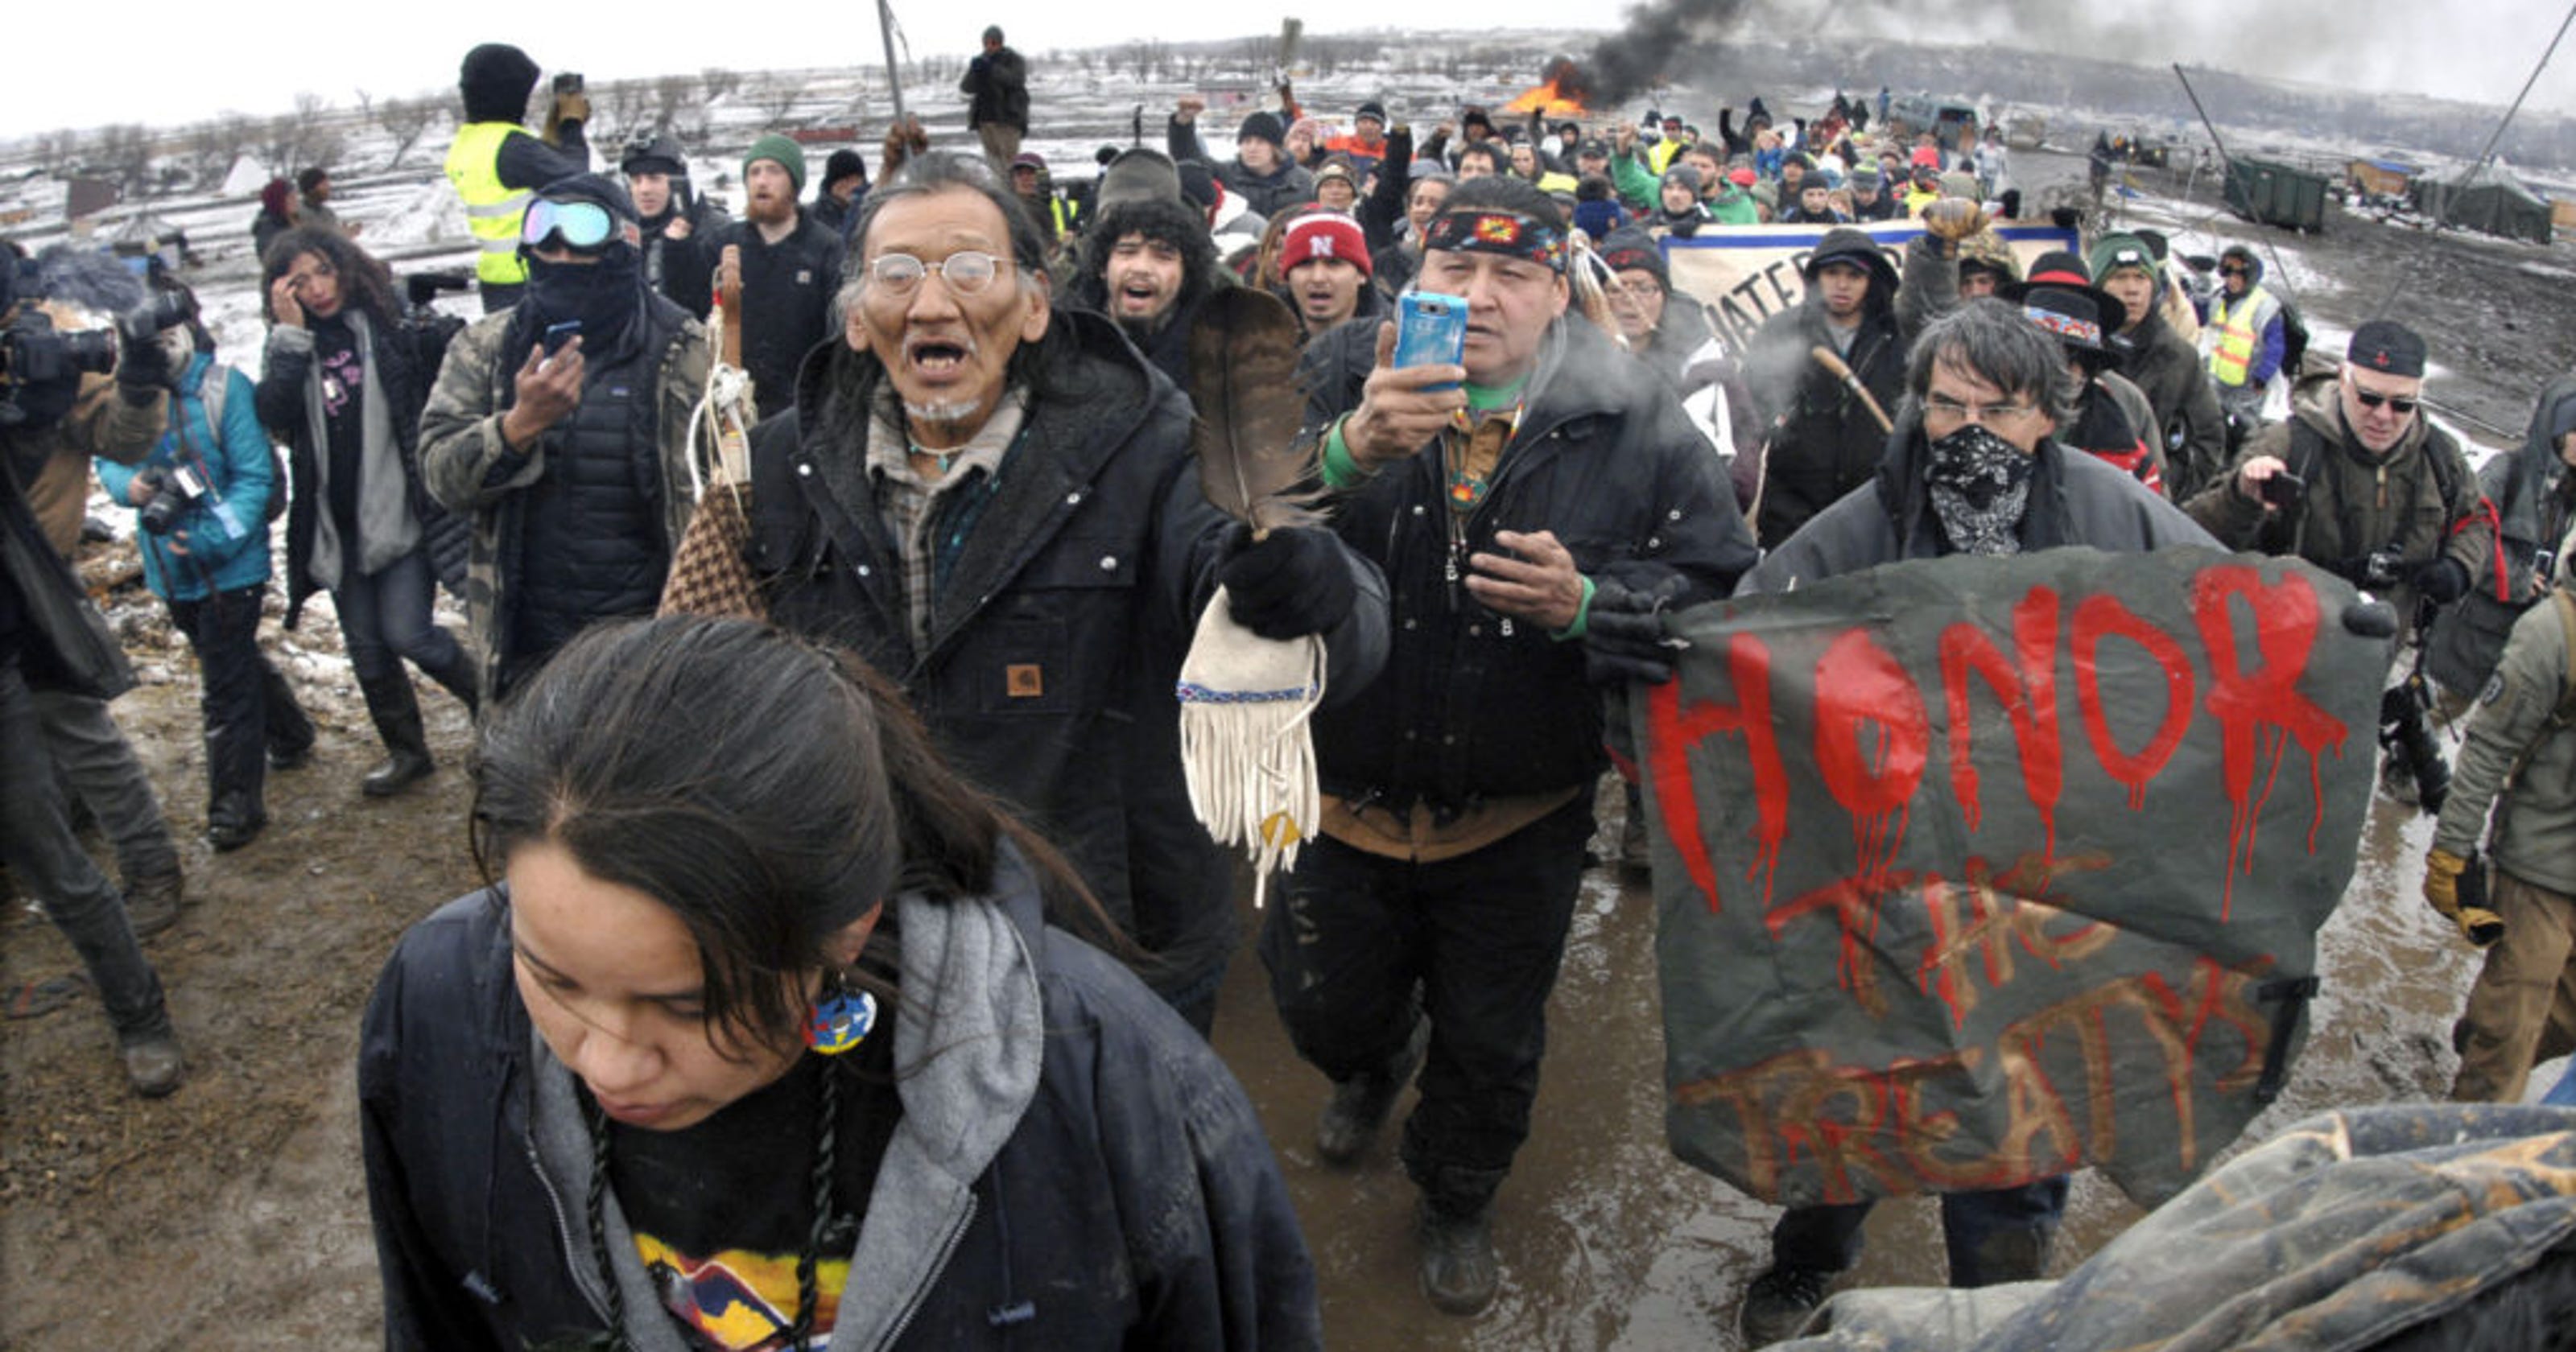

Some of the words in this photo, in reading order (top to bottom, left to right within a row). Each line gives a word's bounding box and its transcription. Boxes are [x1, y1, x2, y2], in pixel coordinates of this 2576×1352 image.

[1309, 234, 1334, 257] N
[1706, 251, 1815, 352] ATE
[1646, 565, 2349, 914] HONOR
[1765, 851, 2119, 1027] THE
